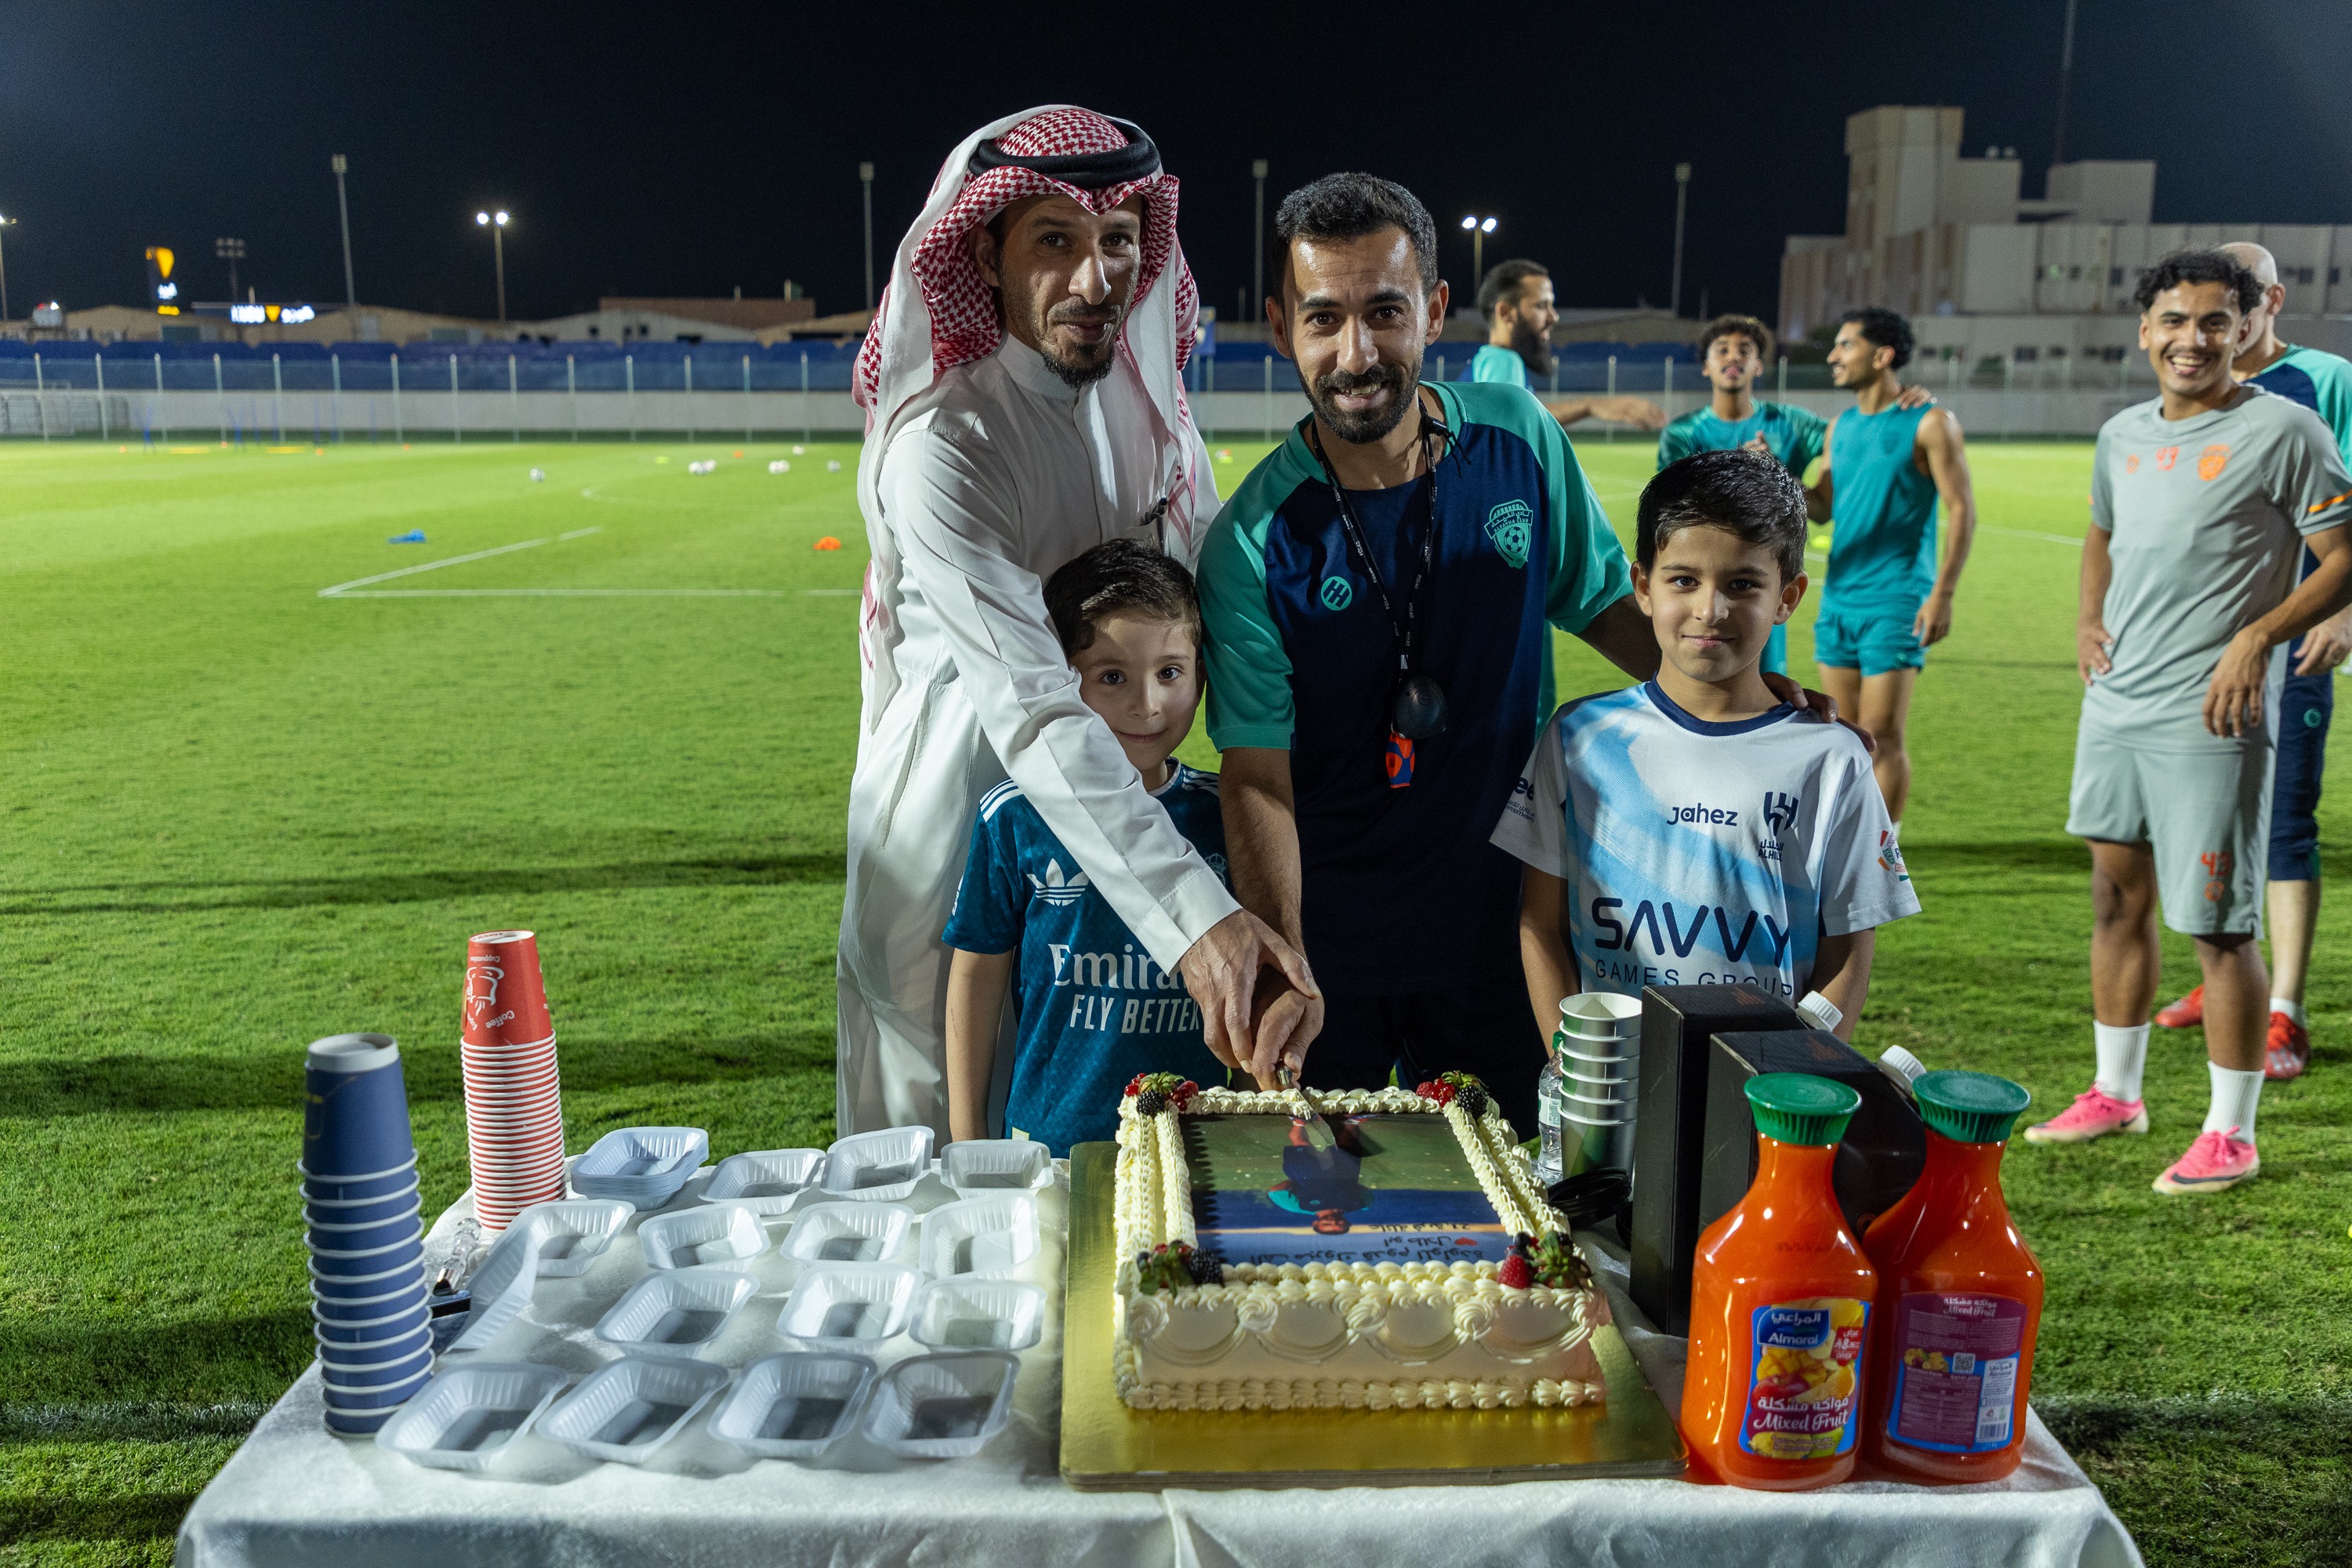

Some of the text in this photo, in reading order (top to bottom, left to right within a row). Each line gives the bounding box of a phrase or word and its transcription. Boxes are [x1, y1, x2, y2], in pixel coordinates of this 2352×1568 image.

[1494, 519, 1515, 533] ALFAYHA
[1355, 540, 1364, 557] FOX40
[1592, 897, 1790, 968] SAVVY
[1048, 944, 1189, 989] Emira
[1595, 959, 1679, 985] GAMES
[486, 1010, 515, 1029] Coffee
[1069, 993, 1114, 1031] FLY
[1771, 1312, 1821, 1327] المراعي
[1768, 1332, 1819, 1345] Almarai
[1758, 1396, 1849, 1411] مشكلة فواكه
[1753, 1409, 1849, 1430] Mixed Fruit
